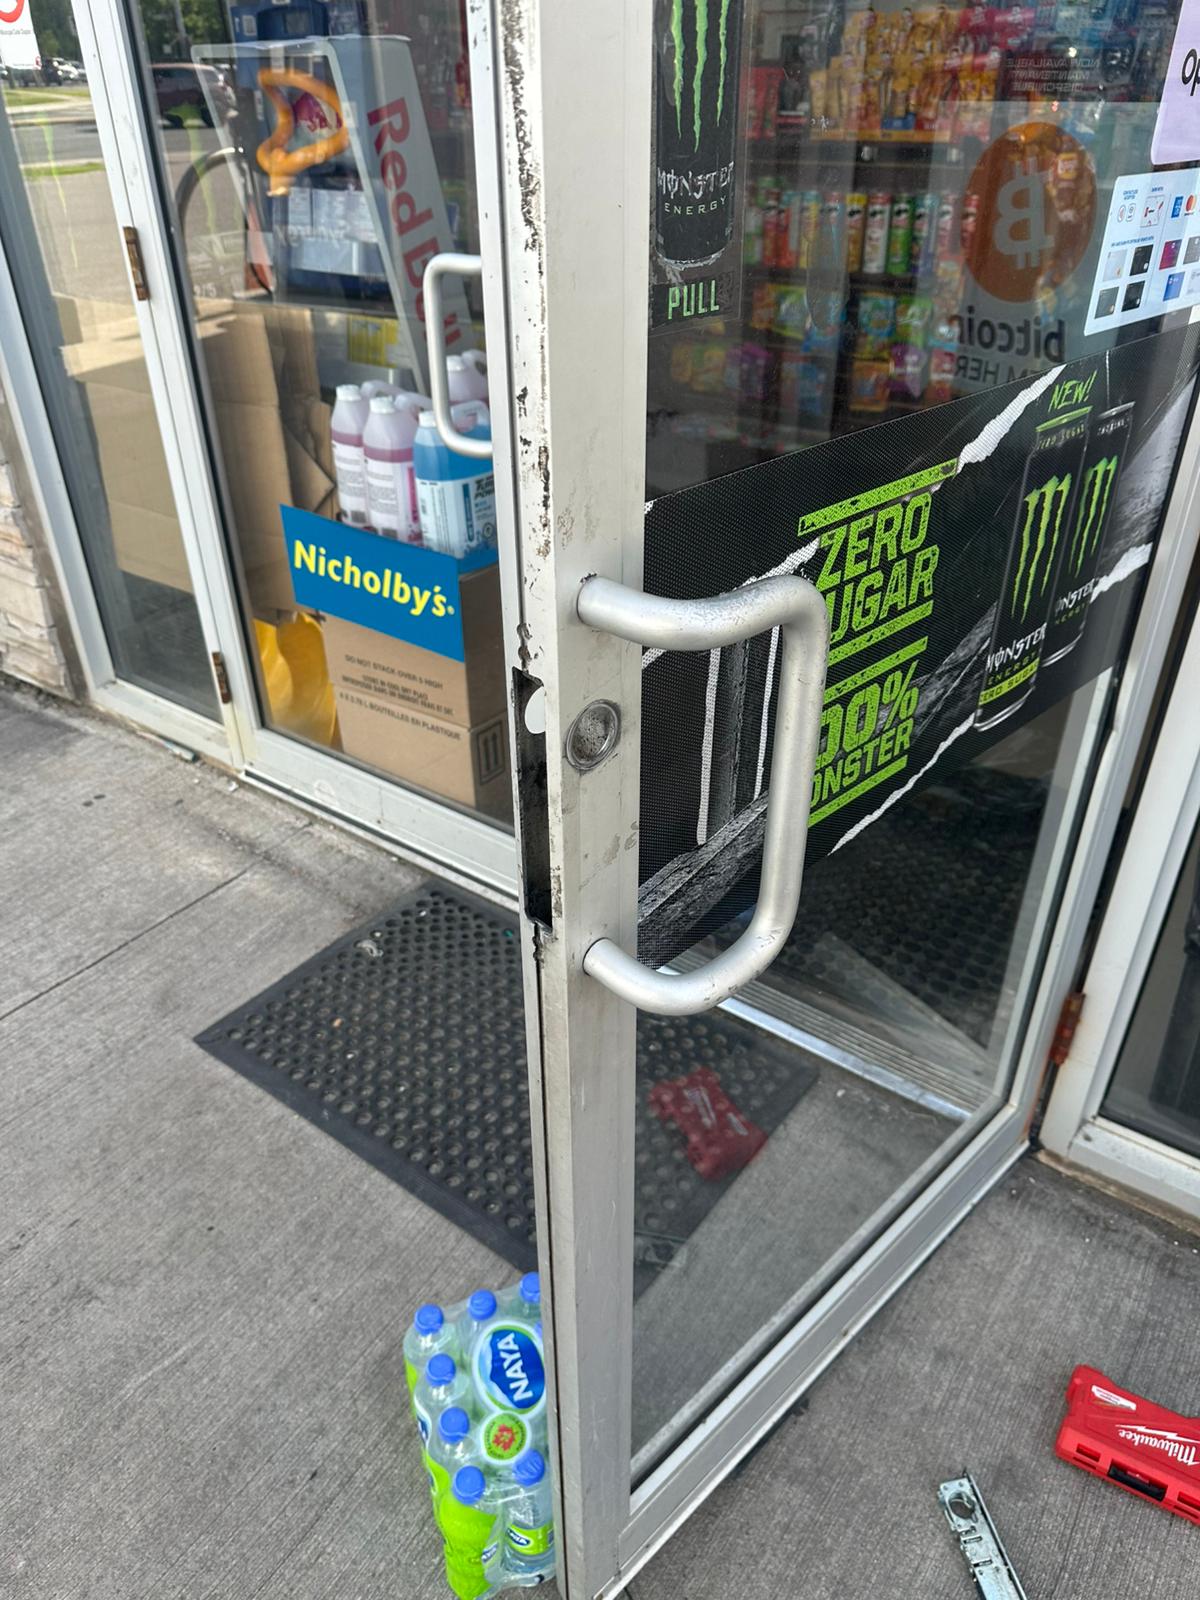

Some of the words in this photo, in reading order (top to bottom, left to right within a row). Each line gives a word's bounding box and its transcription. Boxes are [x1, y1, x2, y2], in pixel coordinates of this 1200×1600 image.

[367, 97, 434, 237] Red
[664, 195, 727, 216] ENERGY
[667, 279, 720, 320] PULL
[1047, 369, 1098, 413] NEW!
[294, 539, 448, 618] Nicholby's
[815, 491, 933, 593] ZERO
[826, 544, 940, 645] UGAR
[815, 660, 920, 772] 00%
[810, 718, 914, 807] ONSTER
[497, 1333, 534, 1403] NAYA
[1118, 1428, 1200, 1467] Milwaukee
